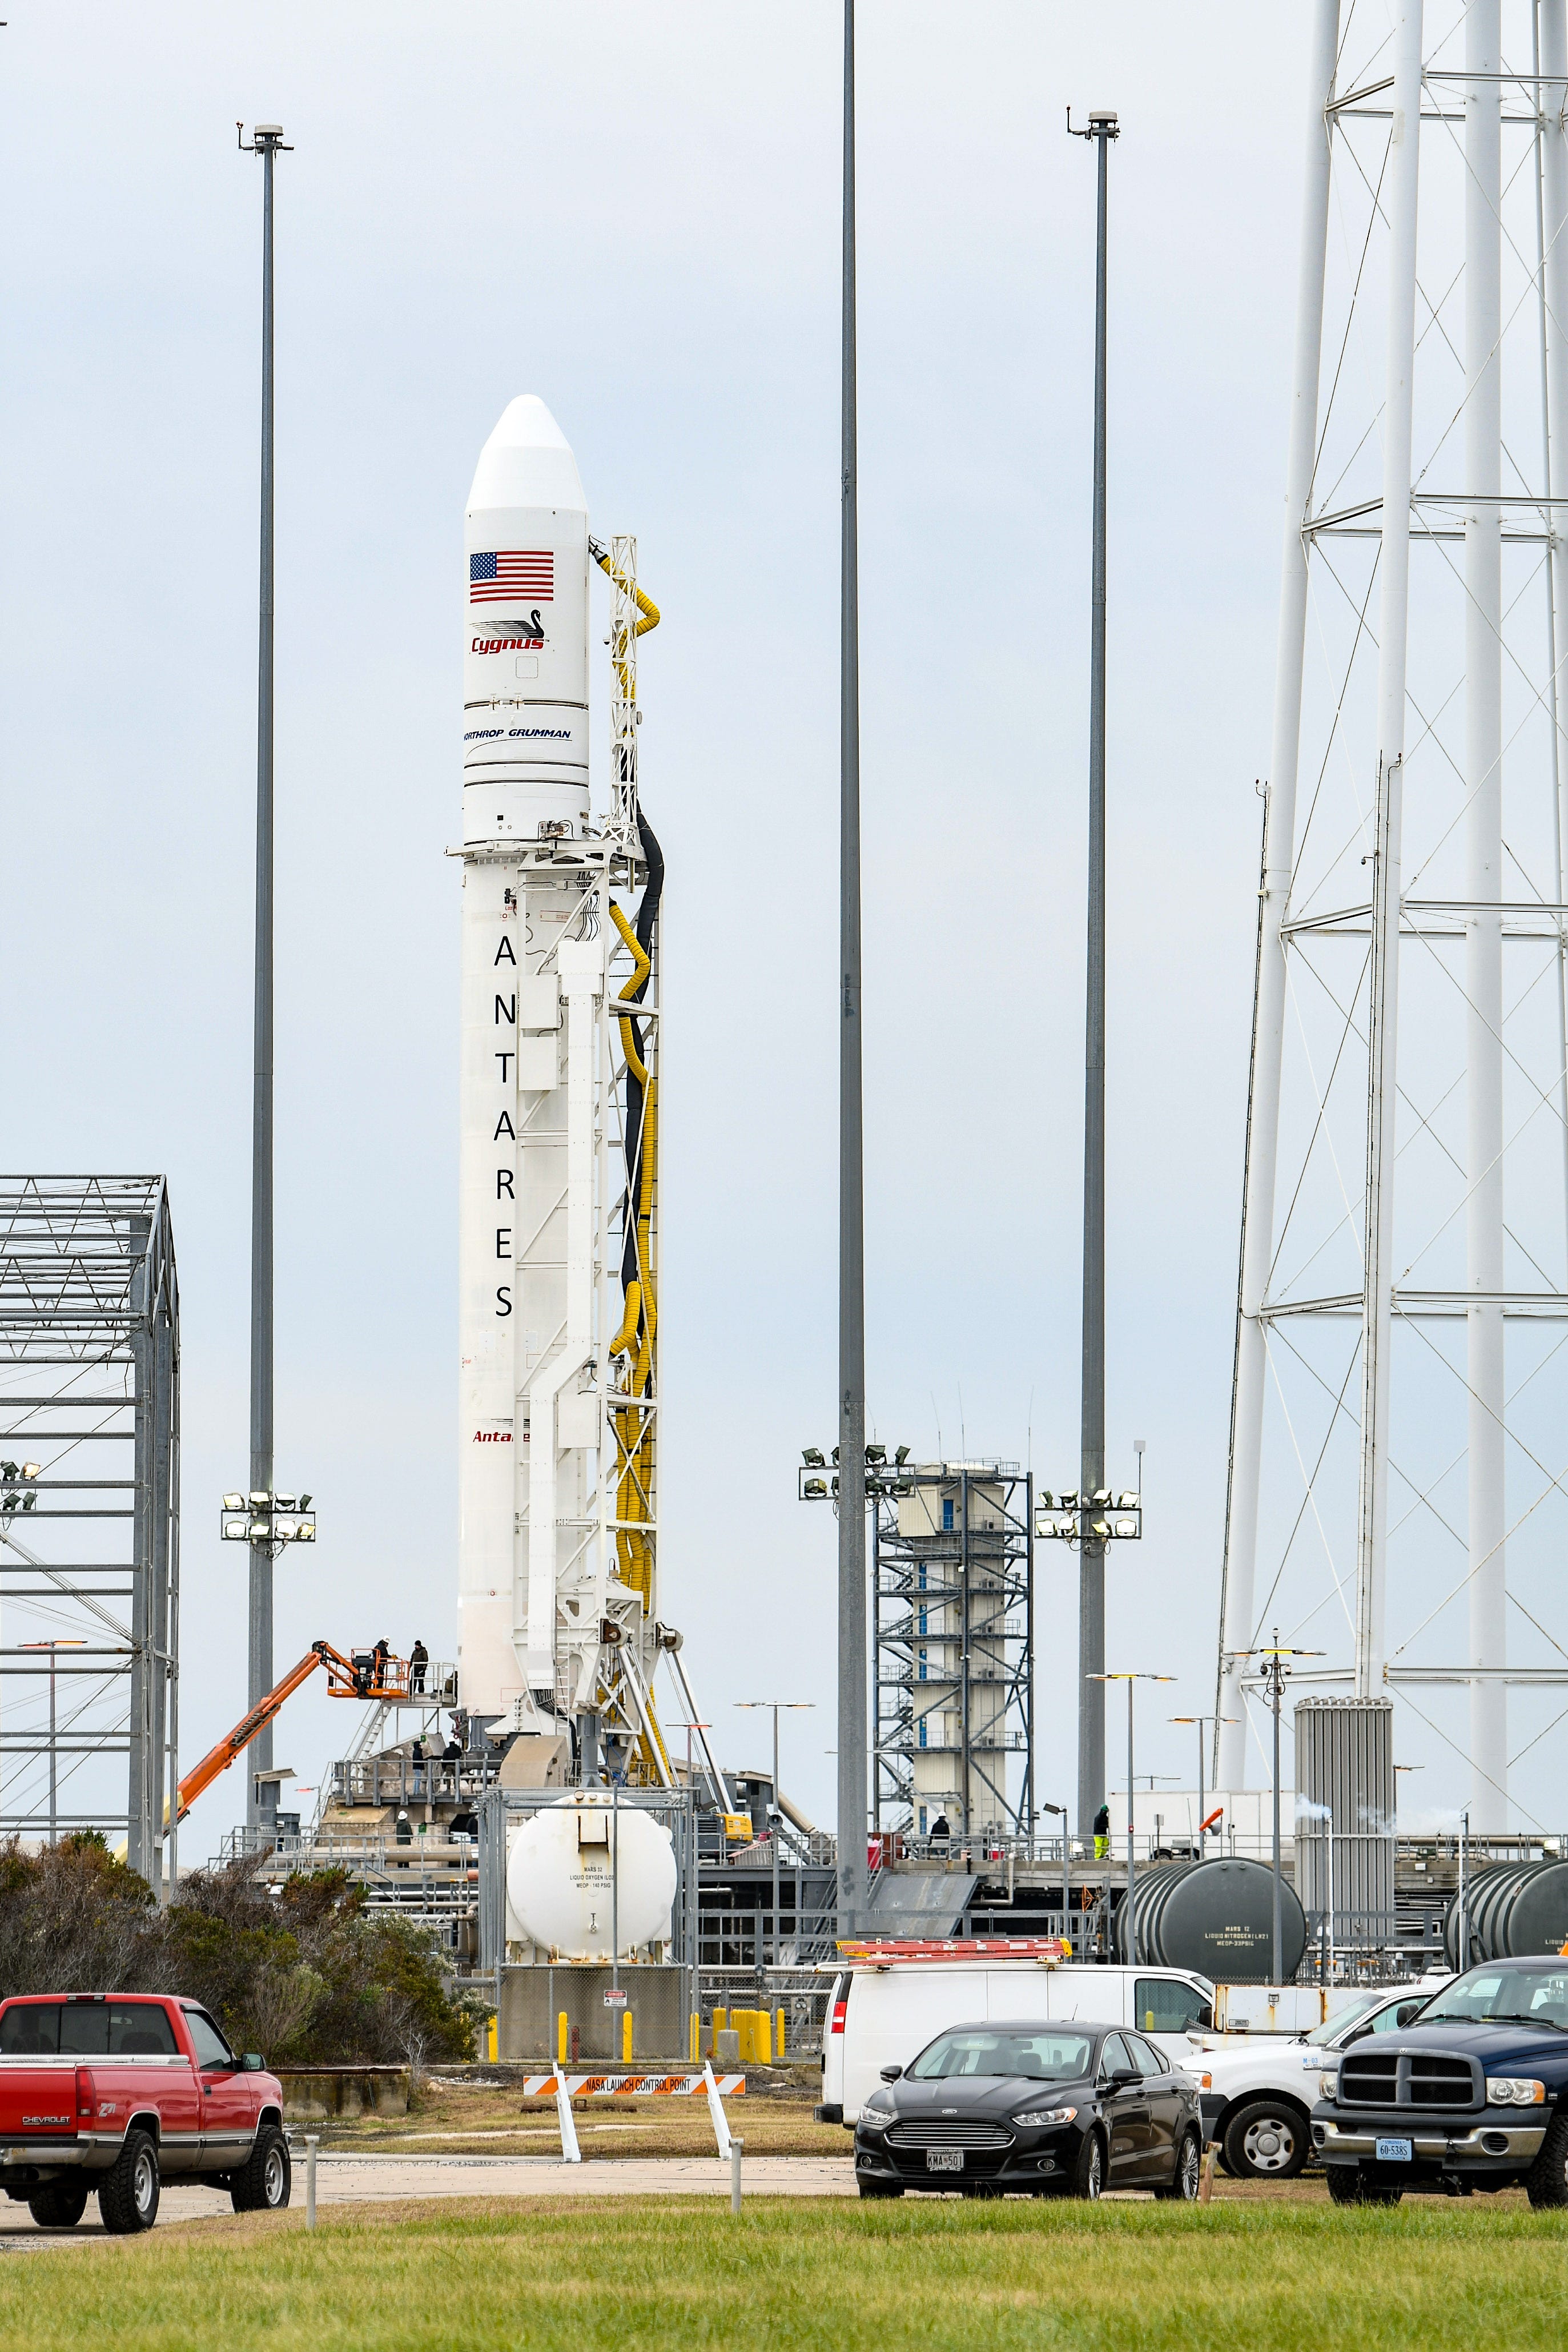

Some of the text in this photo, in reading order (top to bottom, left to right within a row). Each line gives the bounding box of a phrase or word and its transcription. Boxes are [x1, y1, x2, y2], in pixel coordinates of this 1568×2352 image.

[472, 638, 545, 655] Cygnus
[508, 729, 571, 738] GRUMMAN
[494, 935, 517, 1317] ANTARES
[472, 1430, 530, 1442] Antae
[586, 2078, 691, 2092] NASA LAUNCH CONTROL POINT
[98, 2102, 116, 2117] Z71
[1380, 2145, 1408, 2156] 60-538S
[928, 2156, 962, 2166] KMA 501
